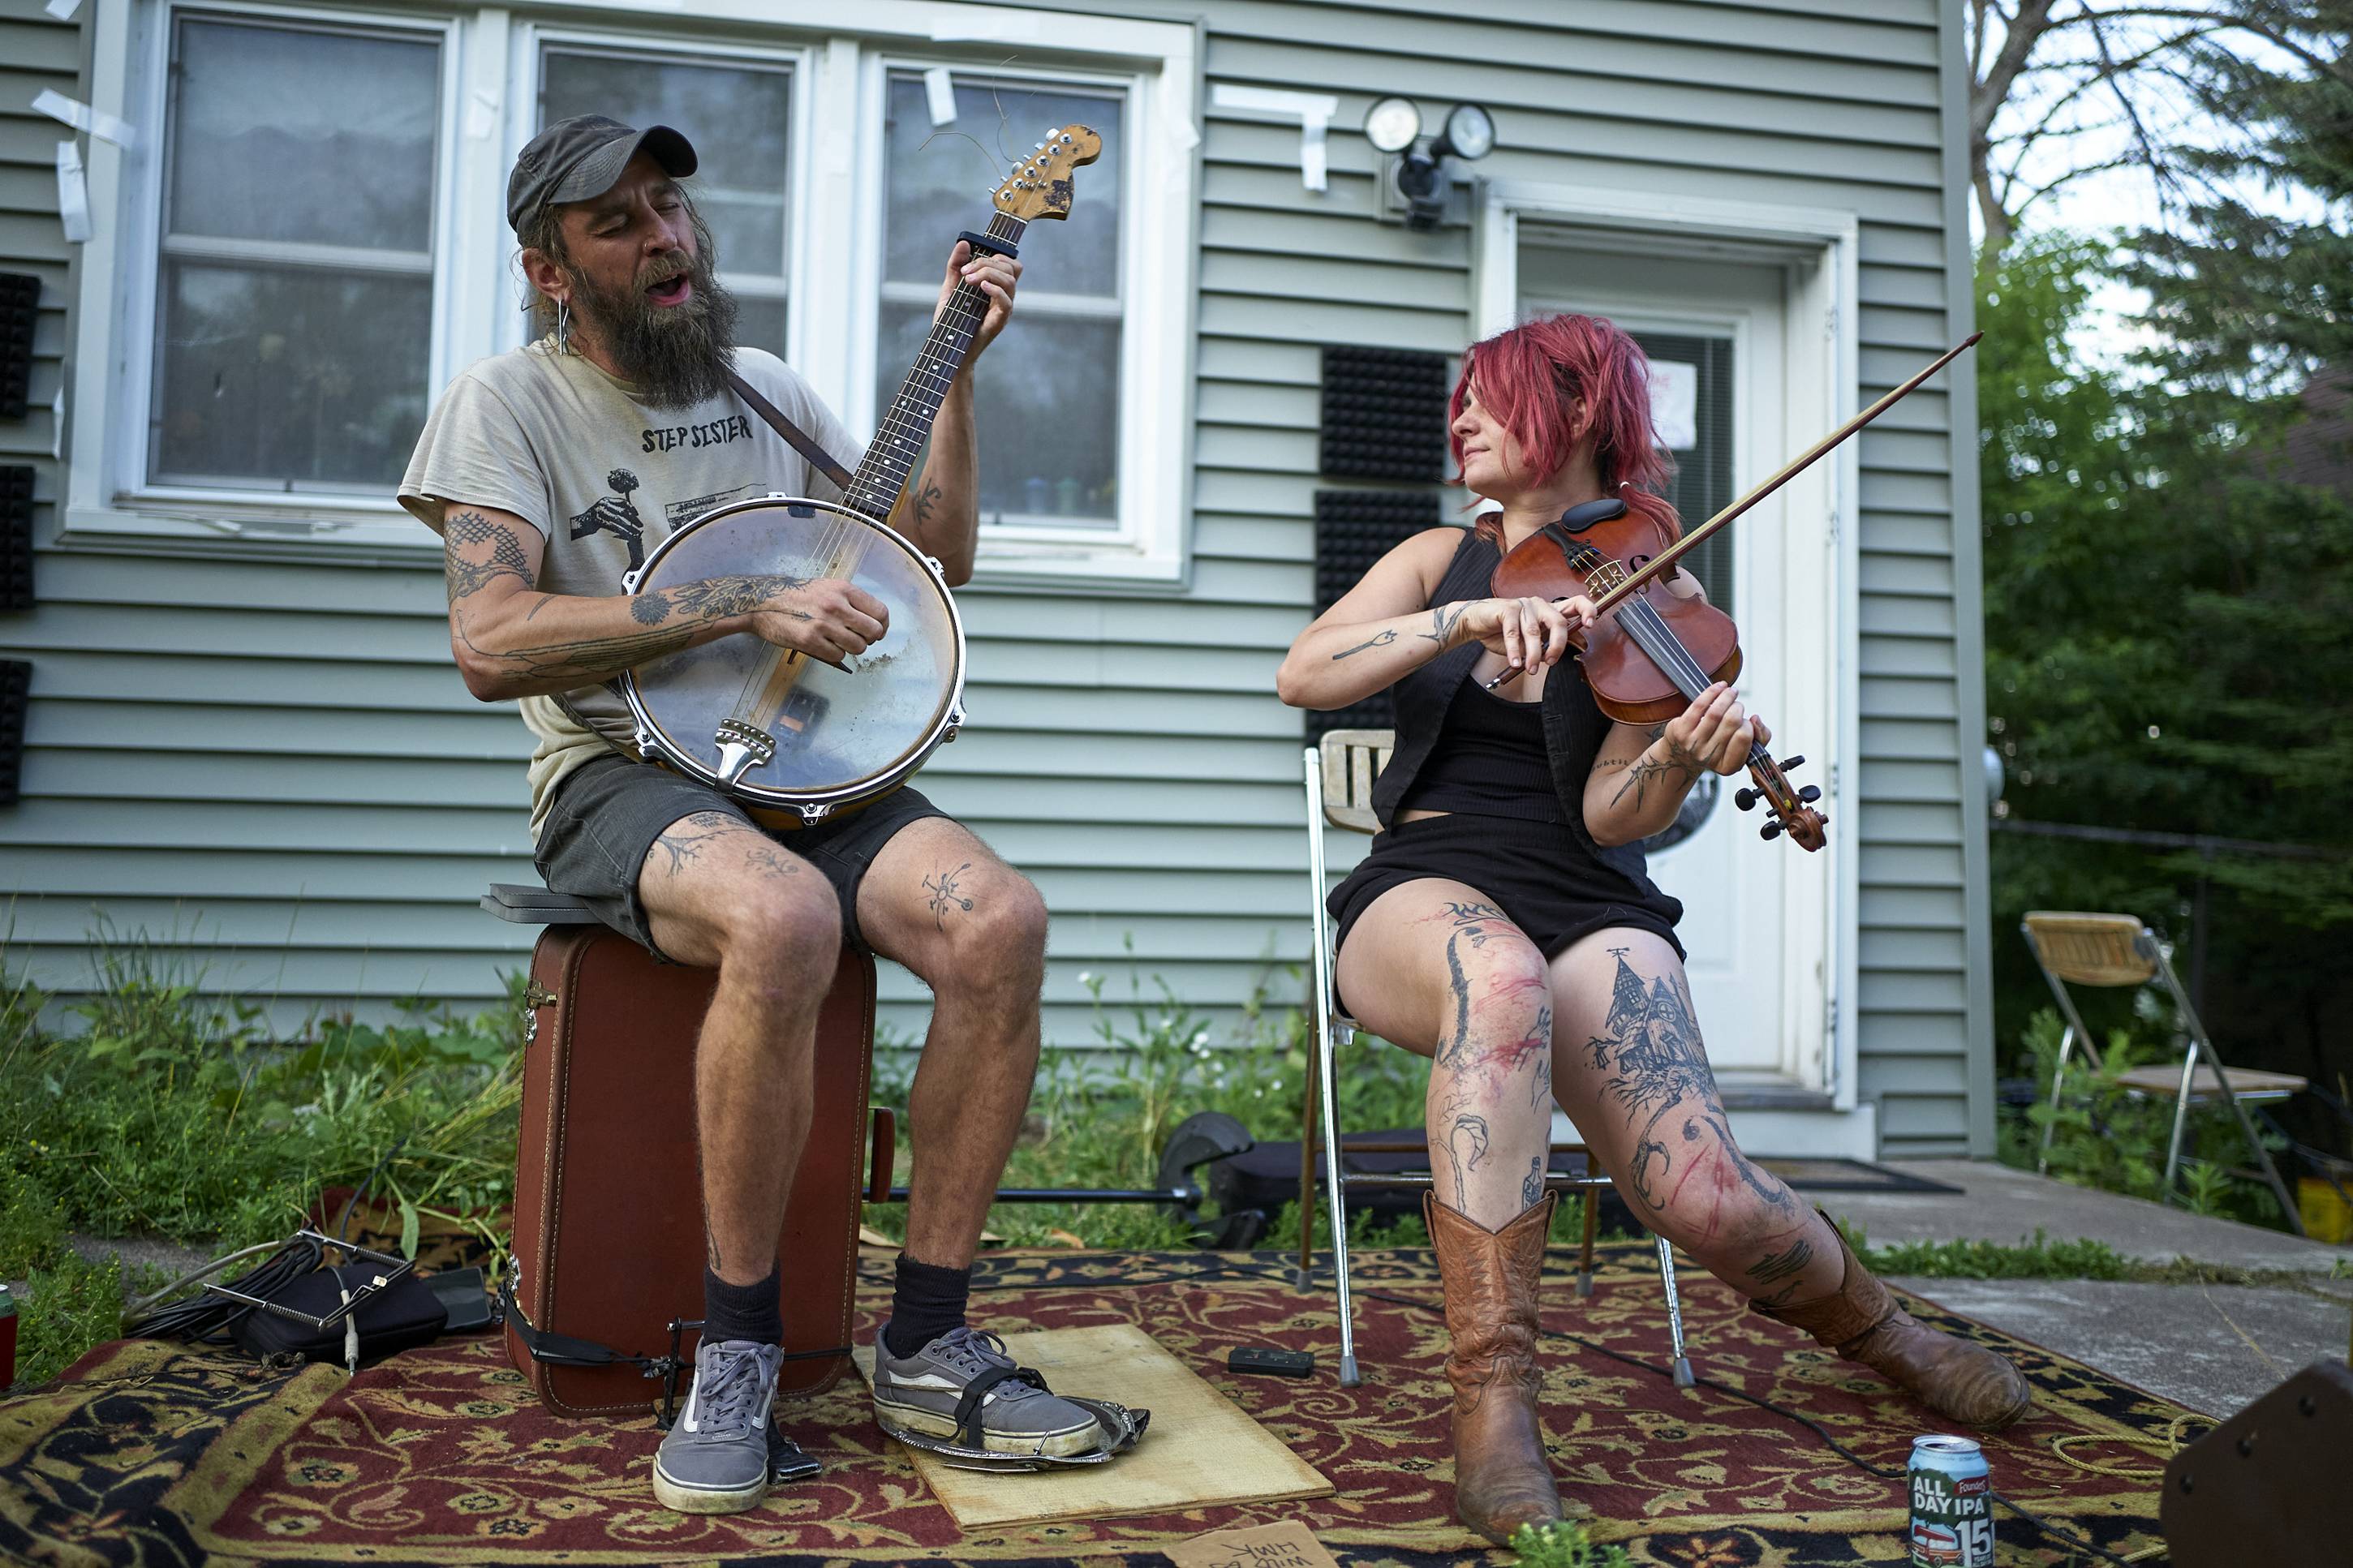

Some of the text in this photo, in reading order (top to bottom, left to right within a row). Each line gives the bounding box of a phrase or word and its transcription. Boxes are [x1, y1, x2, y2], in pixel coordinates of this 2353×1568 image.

[1914, 1476, 1946, 1497] ALL
[1915, 1492, 1985, 1515] DAY IPA
[1955, 1518, 1991, 1568] 15
